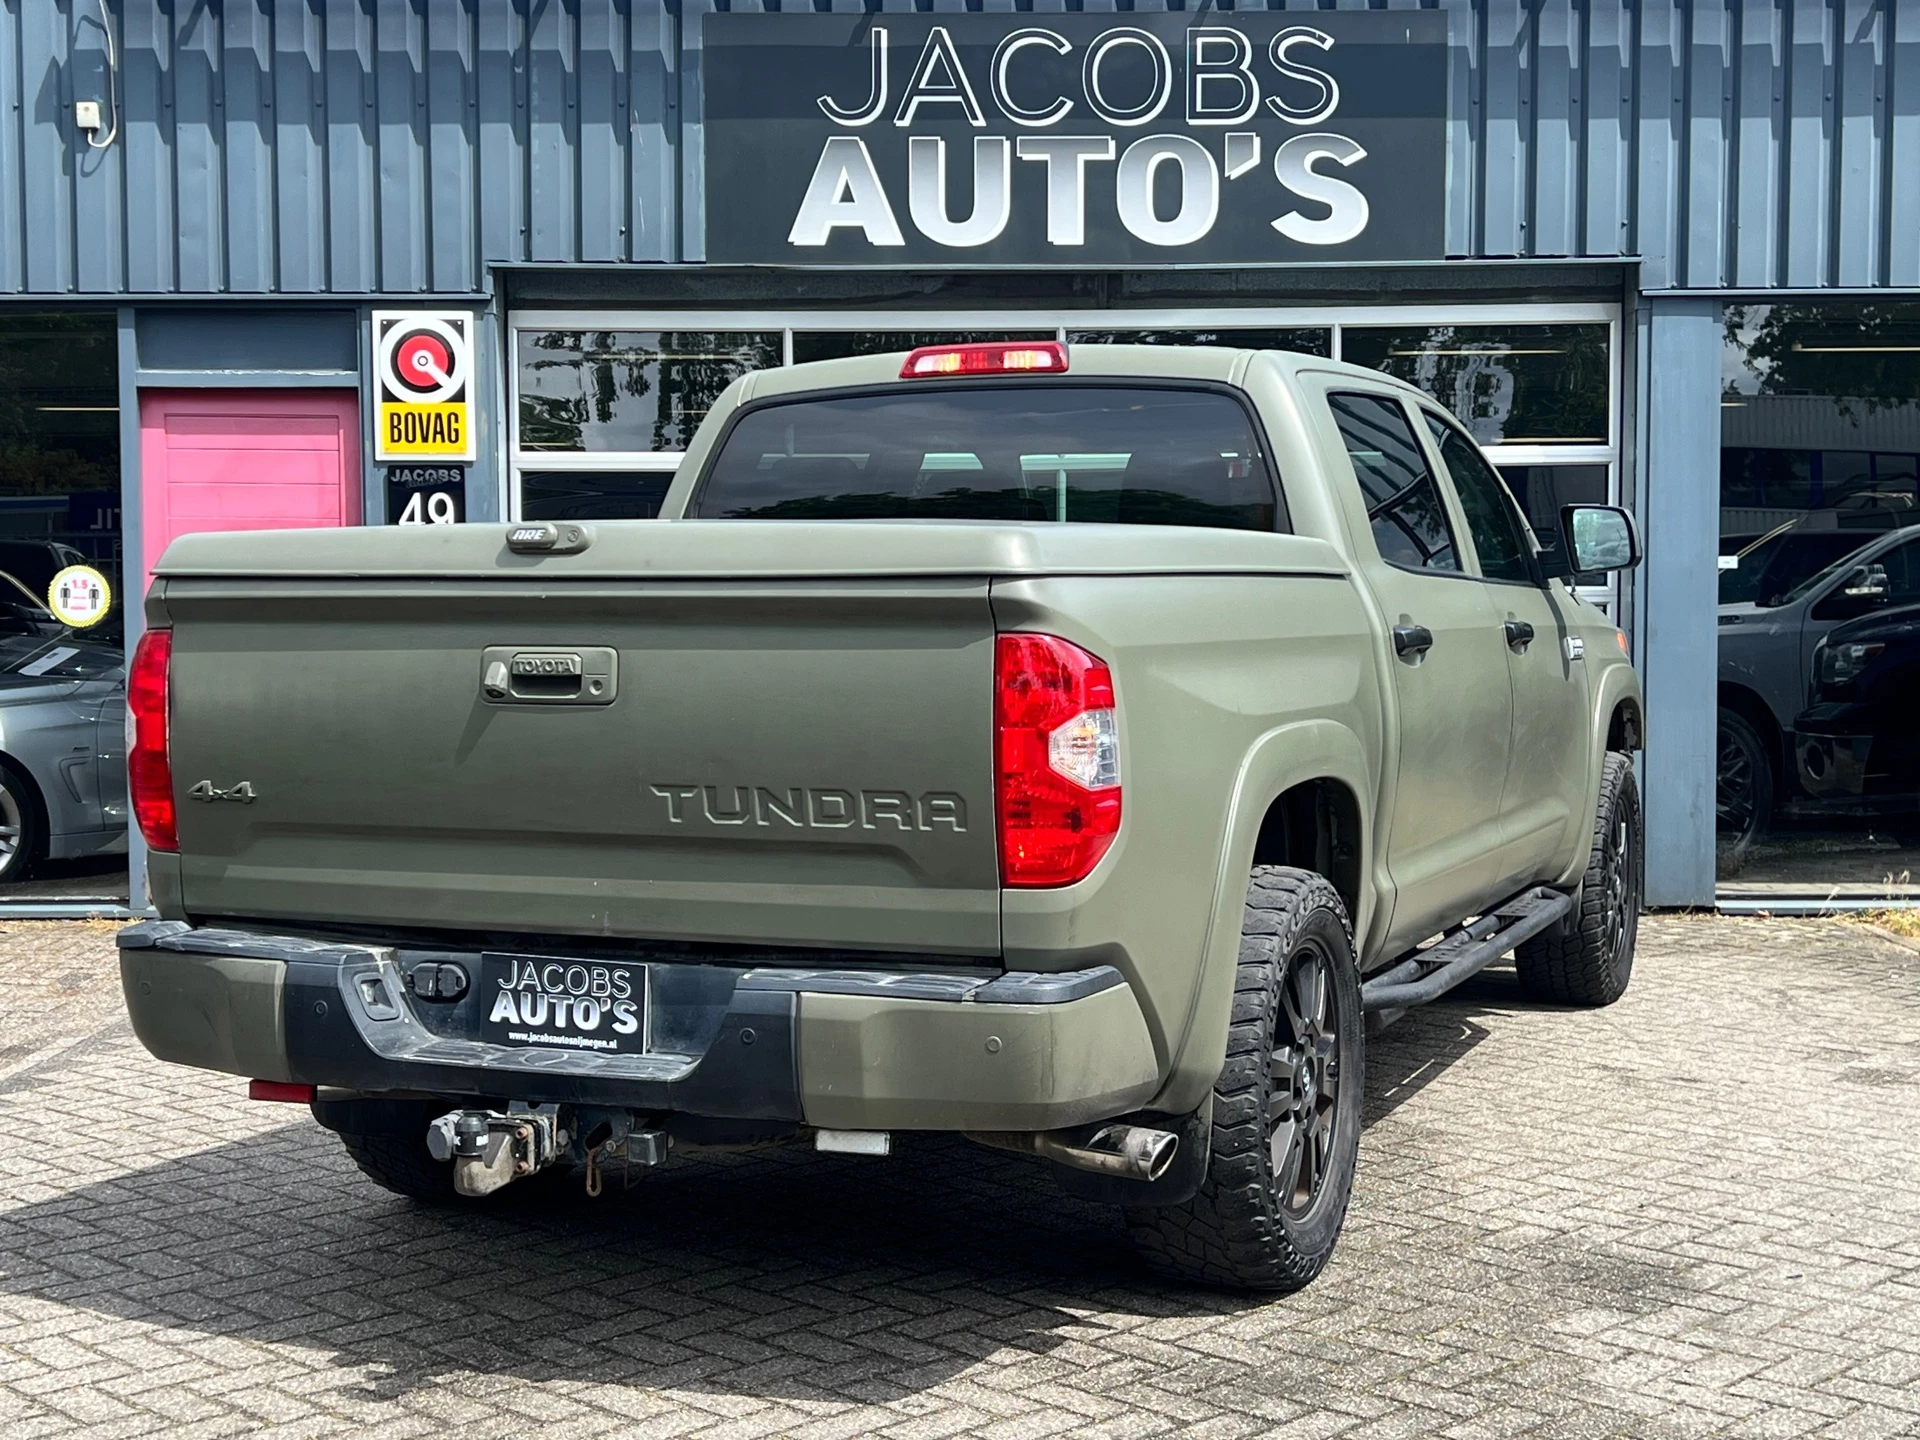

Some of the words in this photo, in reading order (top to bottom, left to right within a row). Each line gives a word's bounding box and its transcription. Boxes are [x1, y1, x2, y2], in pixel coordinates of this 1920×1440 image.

[817, 26, 1340, 127] JACOBS
[787, 132, 1369, 246] AUTO'S
[389, 411, 460, 444] BOVAG
[390, 468, 461, 482] JACOBS
[398, 491, 455, 526] 49
[512, 529, 546, 541] ARE
[72, 579, 89, 590] 1.5
[514, 658, 576, 674] TOYOTA
[649, 783, 968, 832] TUNDRA
[498, 960, 631, 998] JACOBS
[489, 990, 638, 1034] AUTO'S
